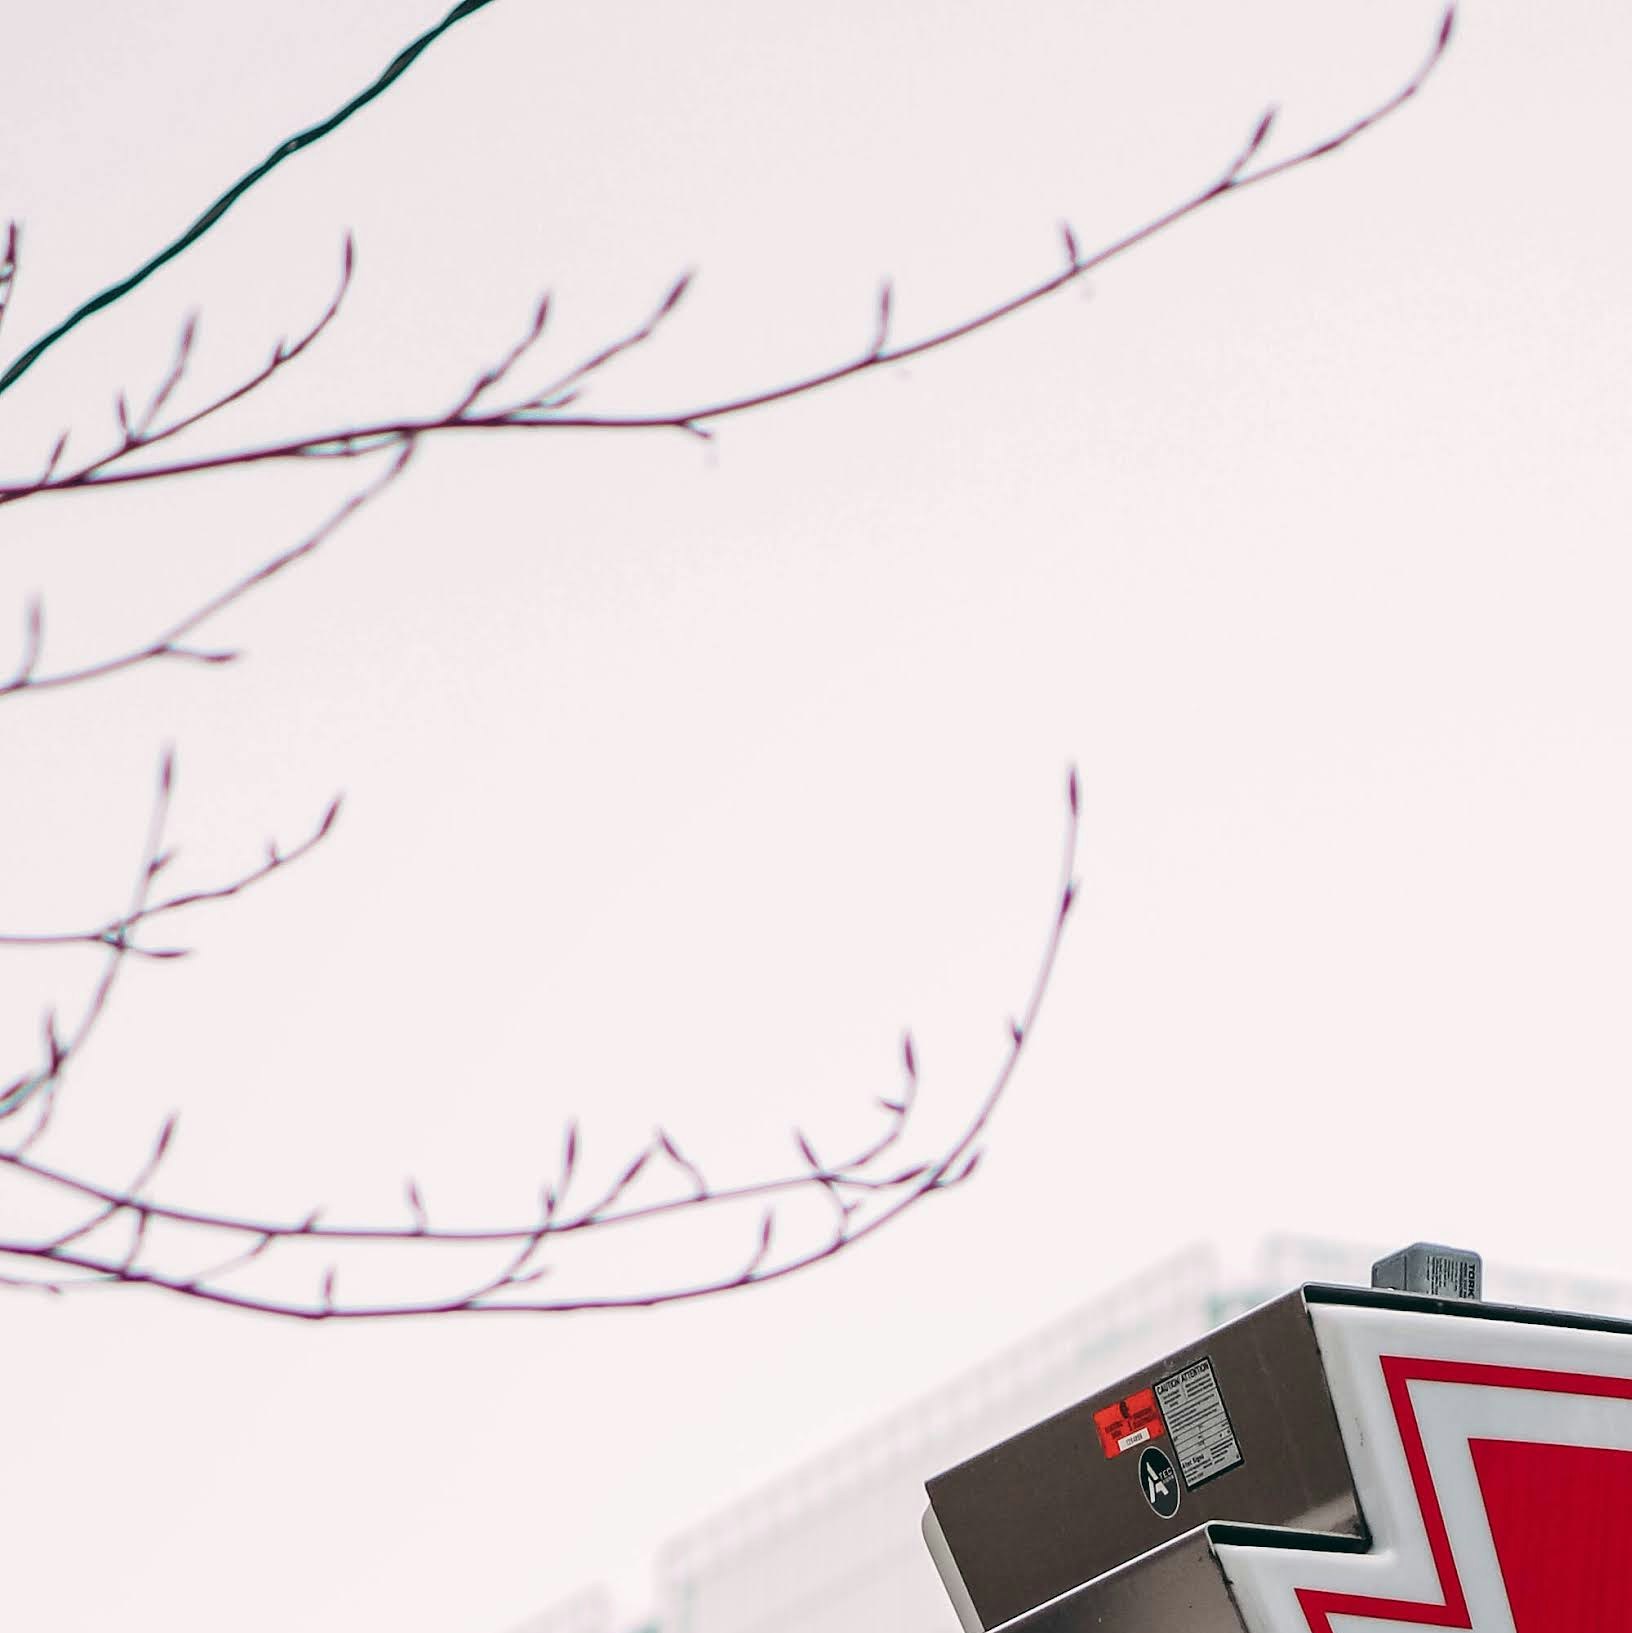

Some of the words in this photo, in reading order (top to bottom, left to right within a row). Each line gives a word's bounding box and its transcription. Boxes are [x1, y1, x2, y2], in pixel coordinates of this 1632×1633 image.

[1467, 1264, 1476, 1299] TORK
[1157, 1376, 1180, 1395] CAUTION
[1180, 1361, 1210, 1382] ATTENTION
